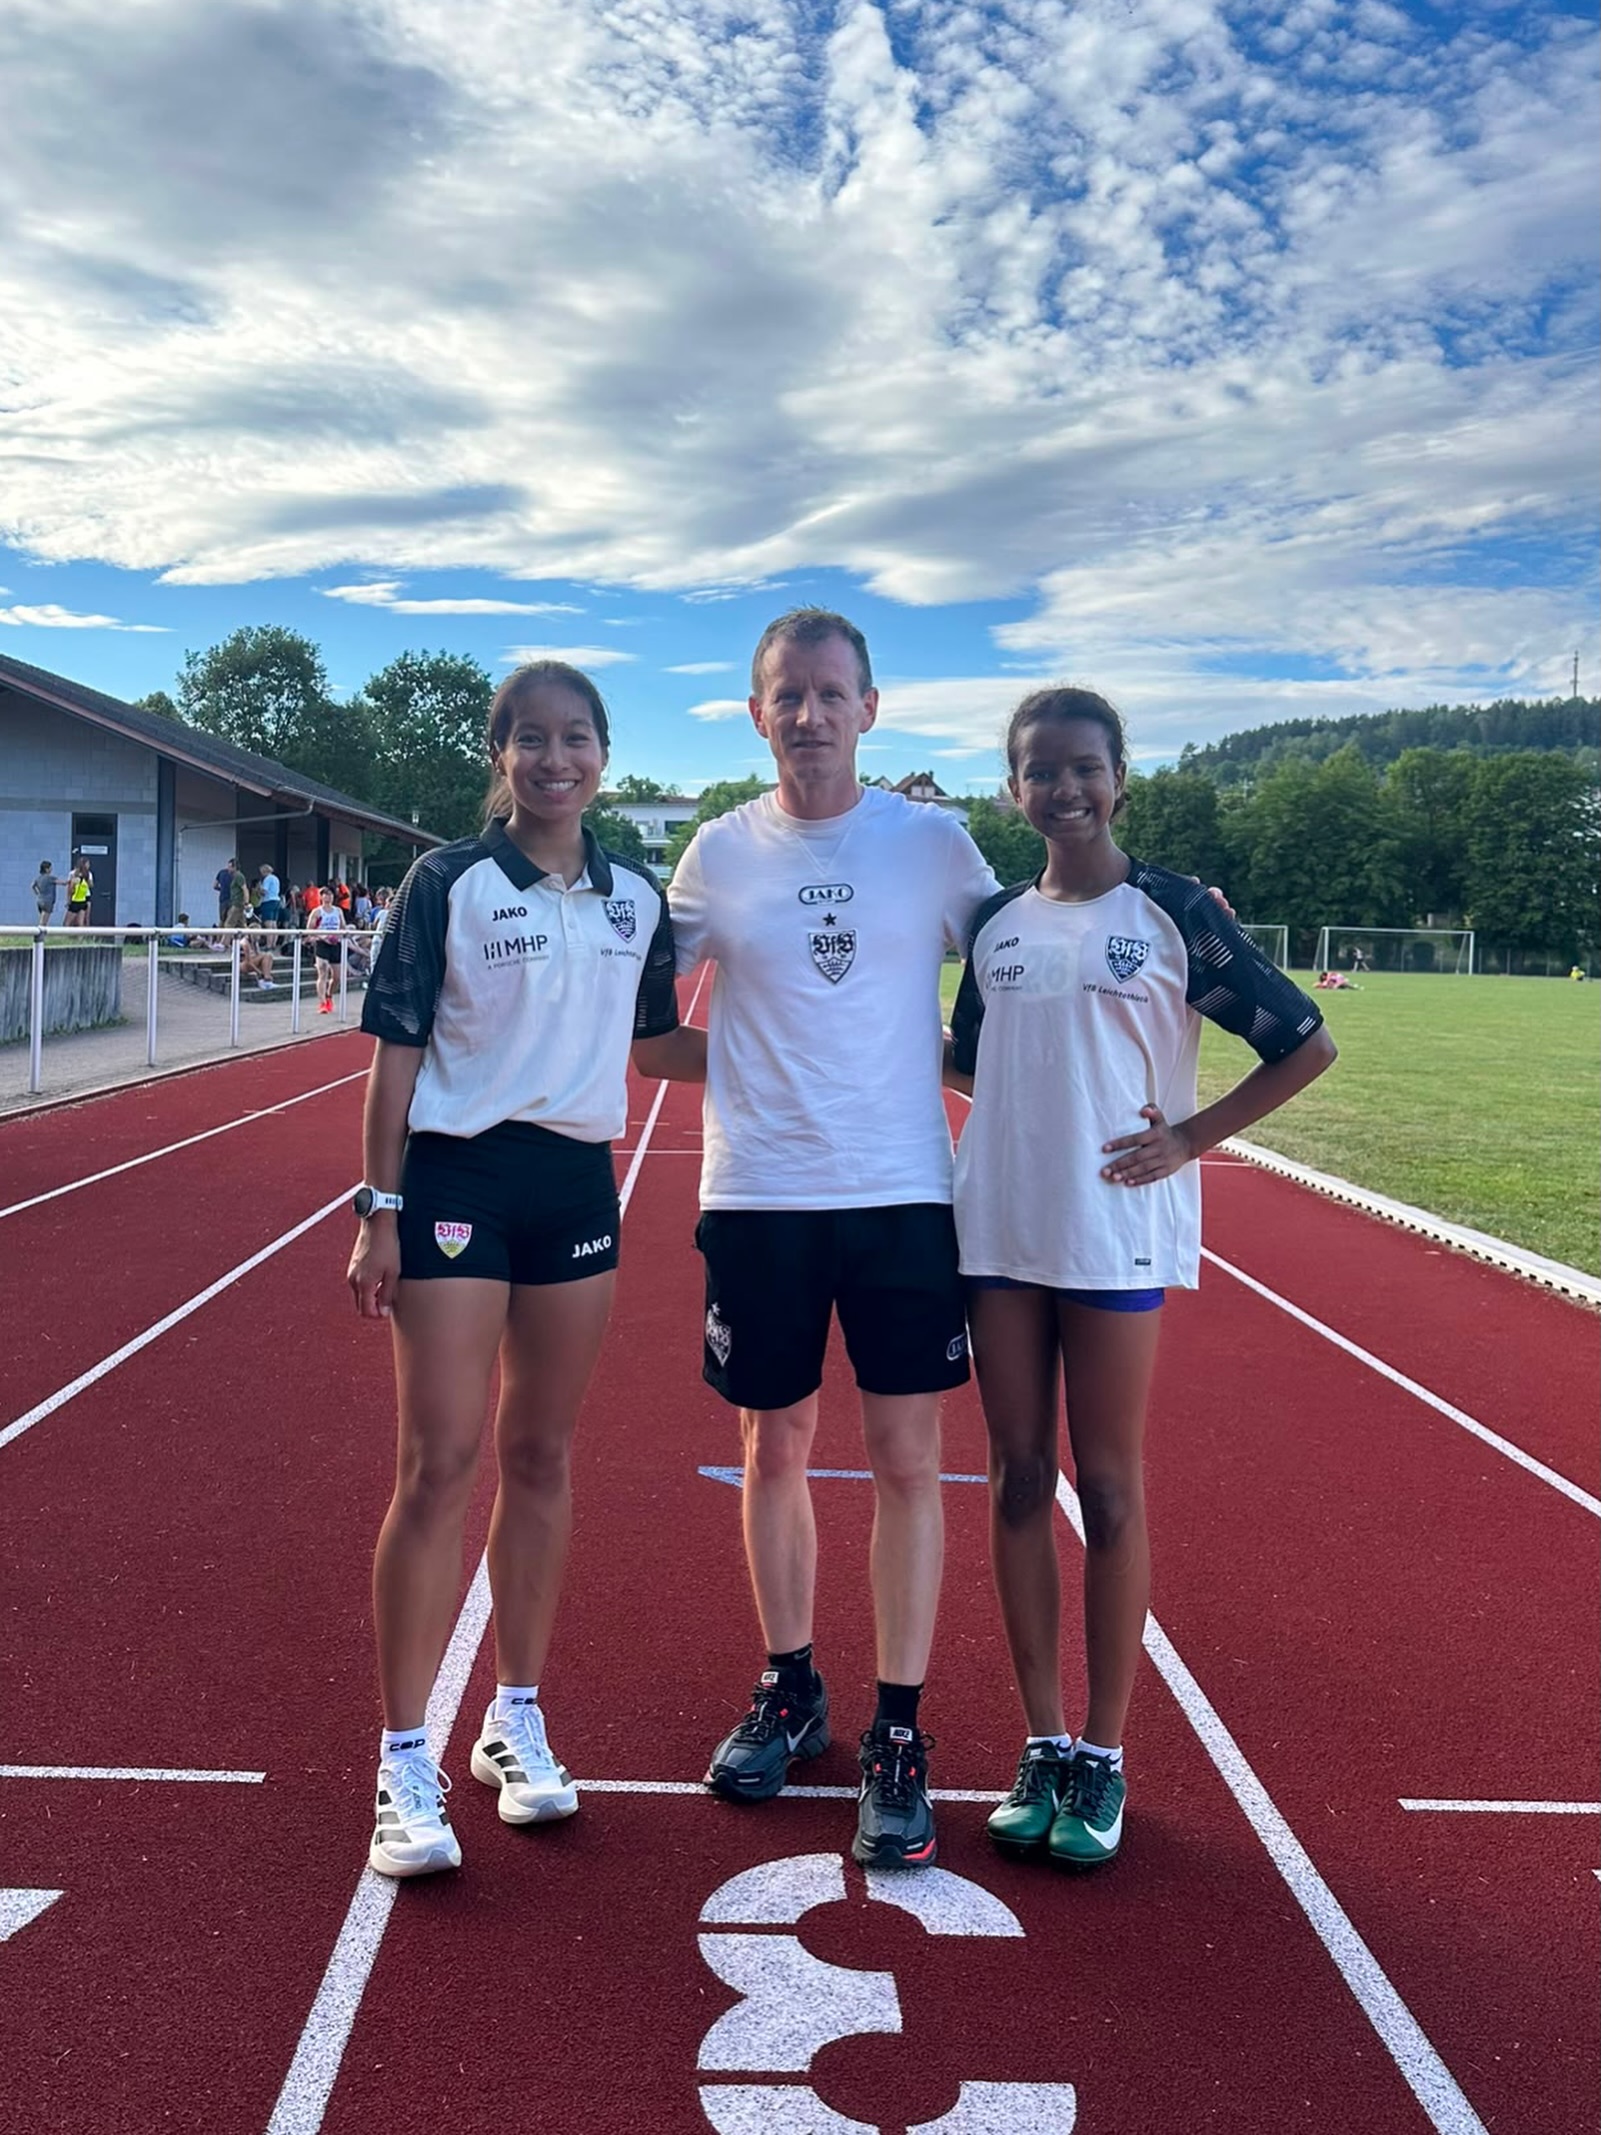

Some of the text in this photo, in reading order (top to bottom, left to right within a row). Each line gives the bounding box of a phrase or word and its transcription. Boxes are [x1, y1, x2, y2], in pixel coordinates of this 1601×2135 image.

[807, 888, 849, 900] JAKO
[492, 906, 528, 922] JAKO
[504, 934, 548, 957] MHP
[993, 936, 1020, 953] JAKO
[1083, 983, 1096, 992] VfB
[572, 1235, 612, 1259] JAKO
[511, 1697, 537, 1705] ce
[697, 1853, 1078, 2135] 3
